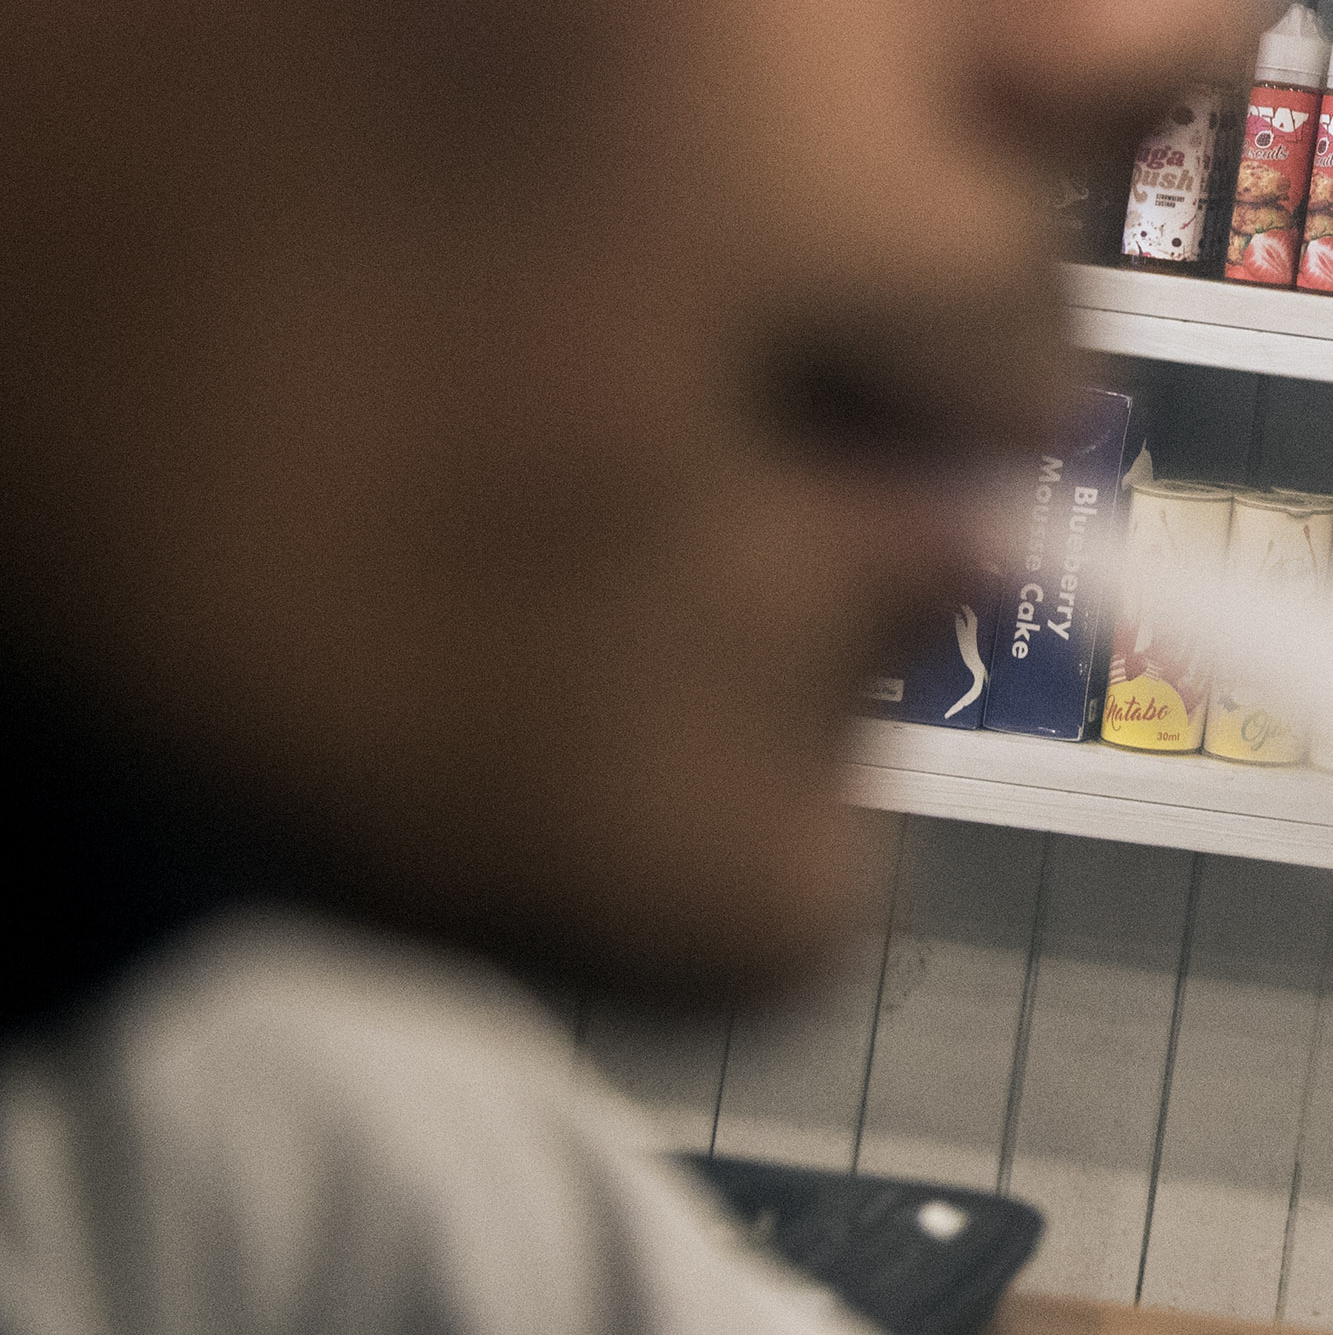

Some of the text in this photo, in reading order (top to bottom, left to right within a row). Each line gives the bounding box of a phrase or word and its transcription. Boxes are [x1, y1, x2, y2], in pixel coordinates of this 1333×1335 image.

[1047, 486, 1098, 641] Blueberry
[1010, 582, 1044, 661] Cake
[1156, 731, 1181, 743] 30ml
